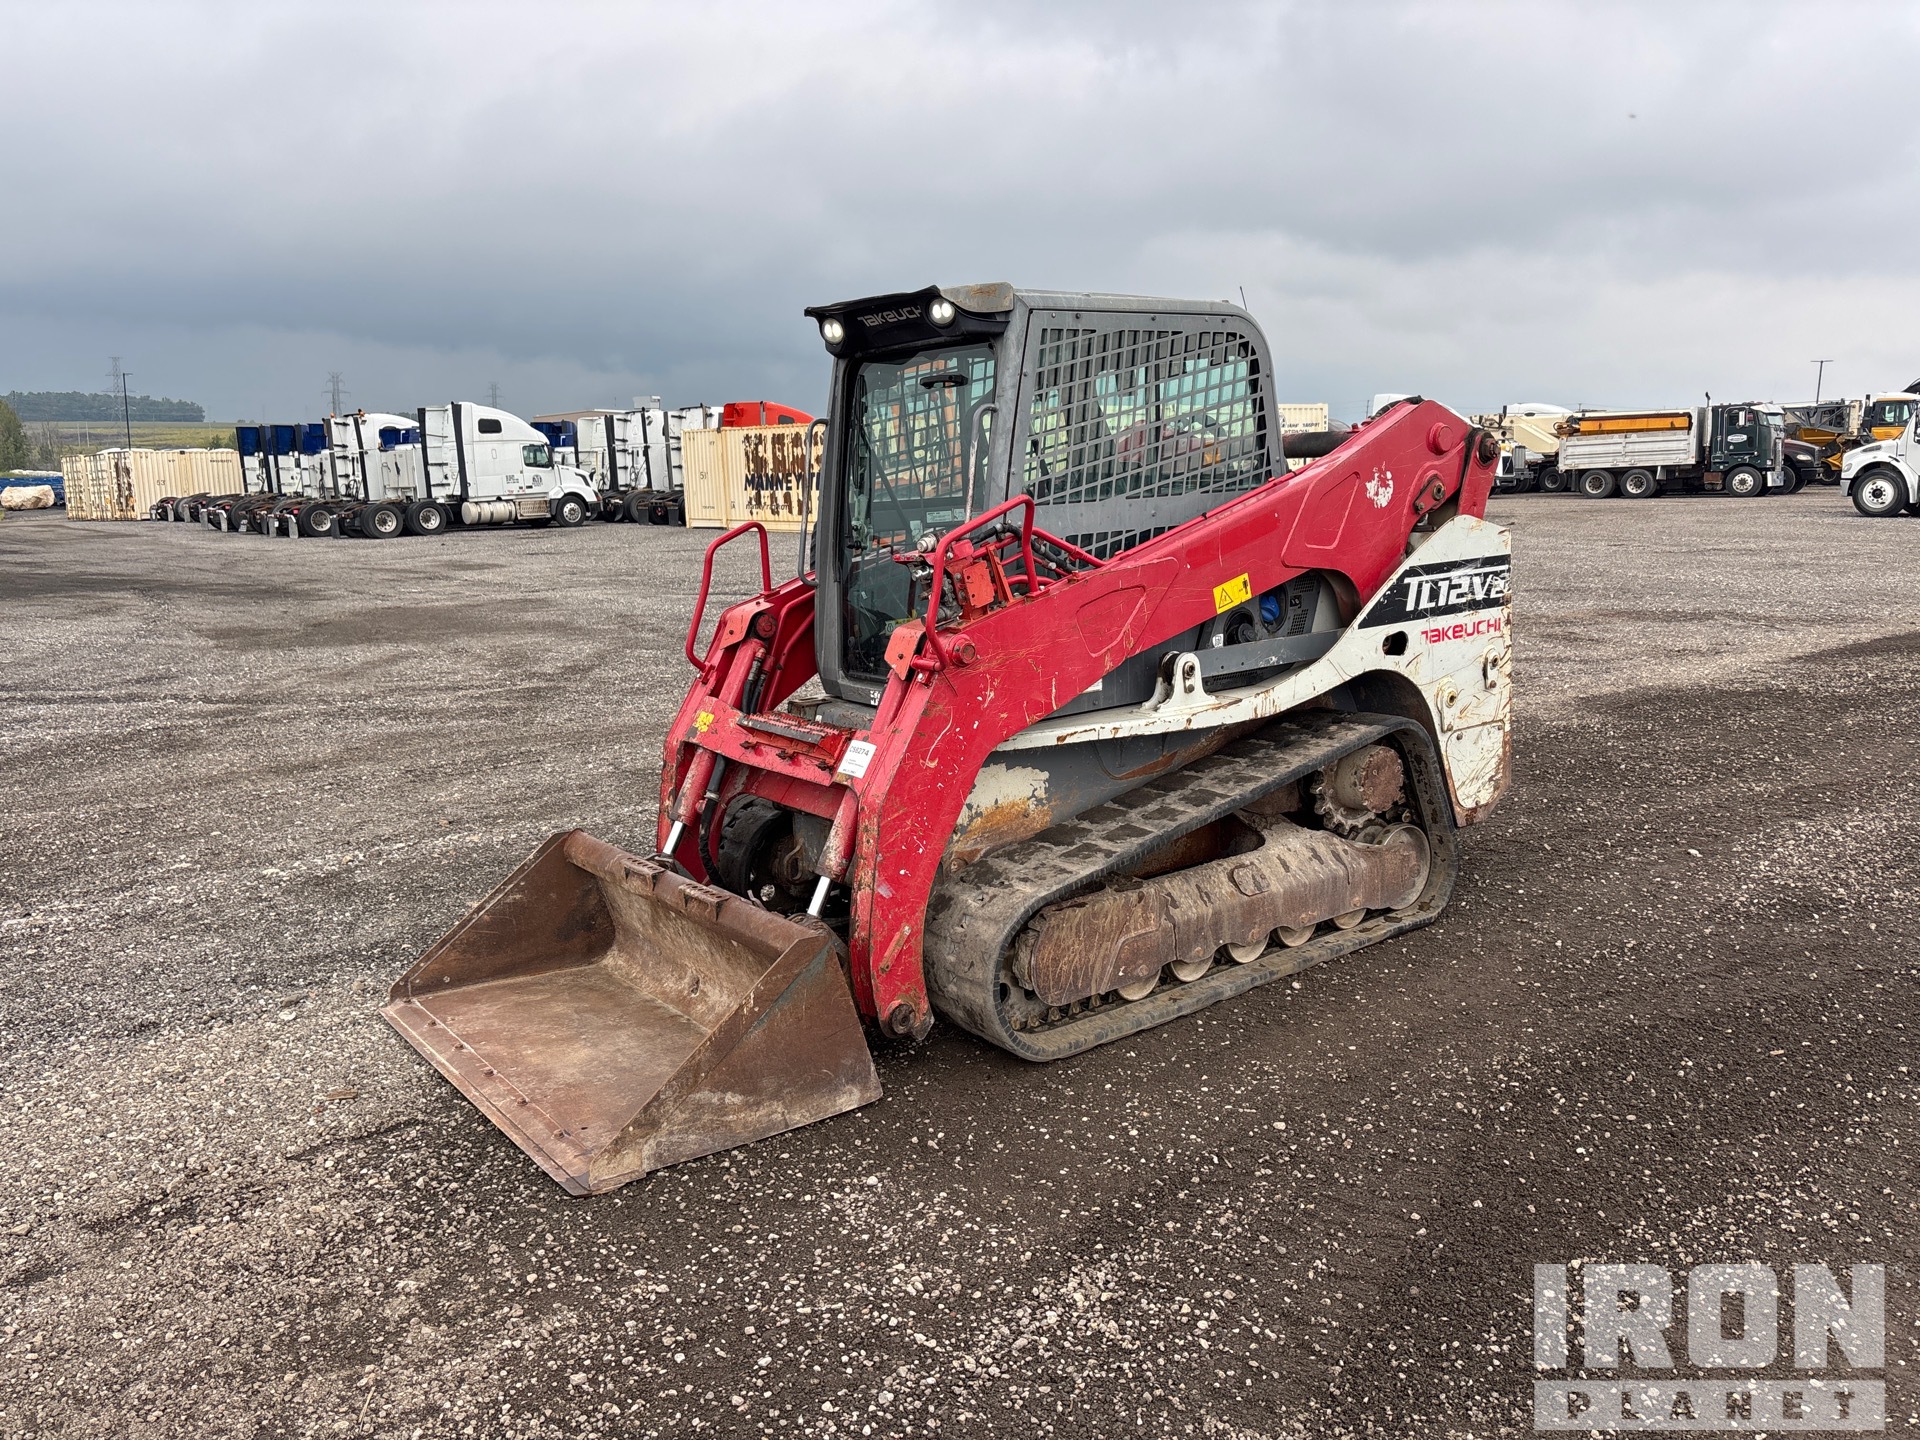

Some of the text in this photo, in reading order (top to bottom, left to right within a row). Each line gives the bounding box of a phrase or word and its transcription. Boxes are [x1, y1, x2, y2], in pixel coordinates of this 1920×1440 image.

[857, 305, 922, 327] TAKEUCH
[744, 472, 803, 491] MANNEY
[1421, 617, 1501, 644] TAKEUCHI
